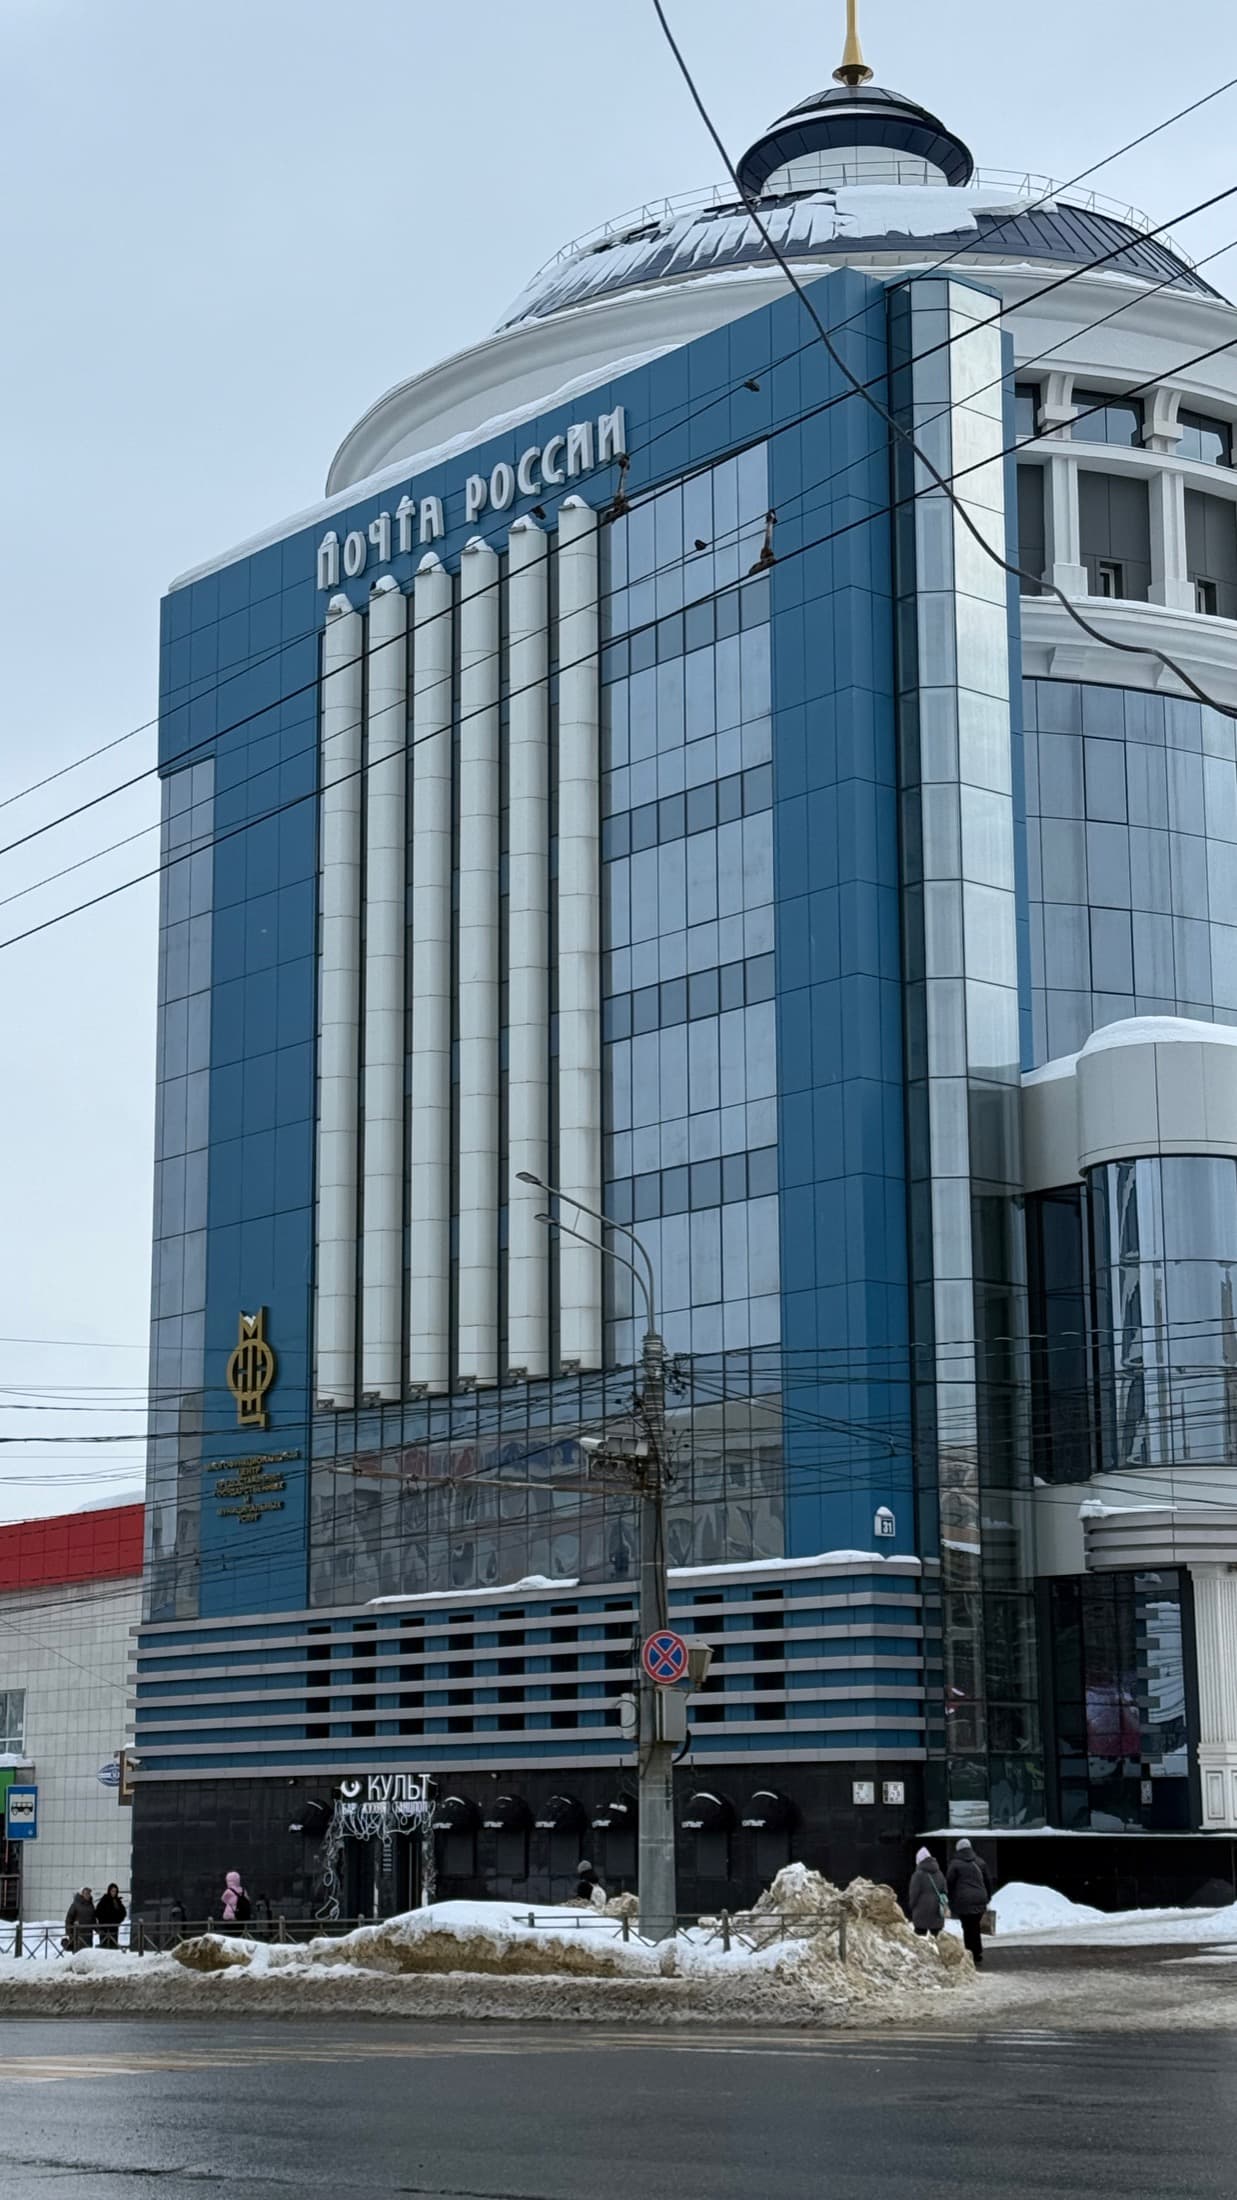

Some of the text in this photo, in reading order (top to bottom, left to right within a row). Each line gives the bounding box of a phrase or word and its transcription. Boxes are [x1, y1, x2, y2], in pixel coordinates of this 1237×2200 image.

[317, 405, 627, 590] ПОЧТА РОССИИ
[367, 1774, 431, 1801] КУЛЬТ
